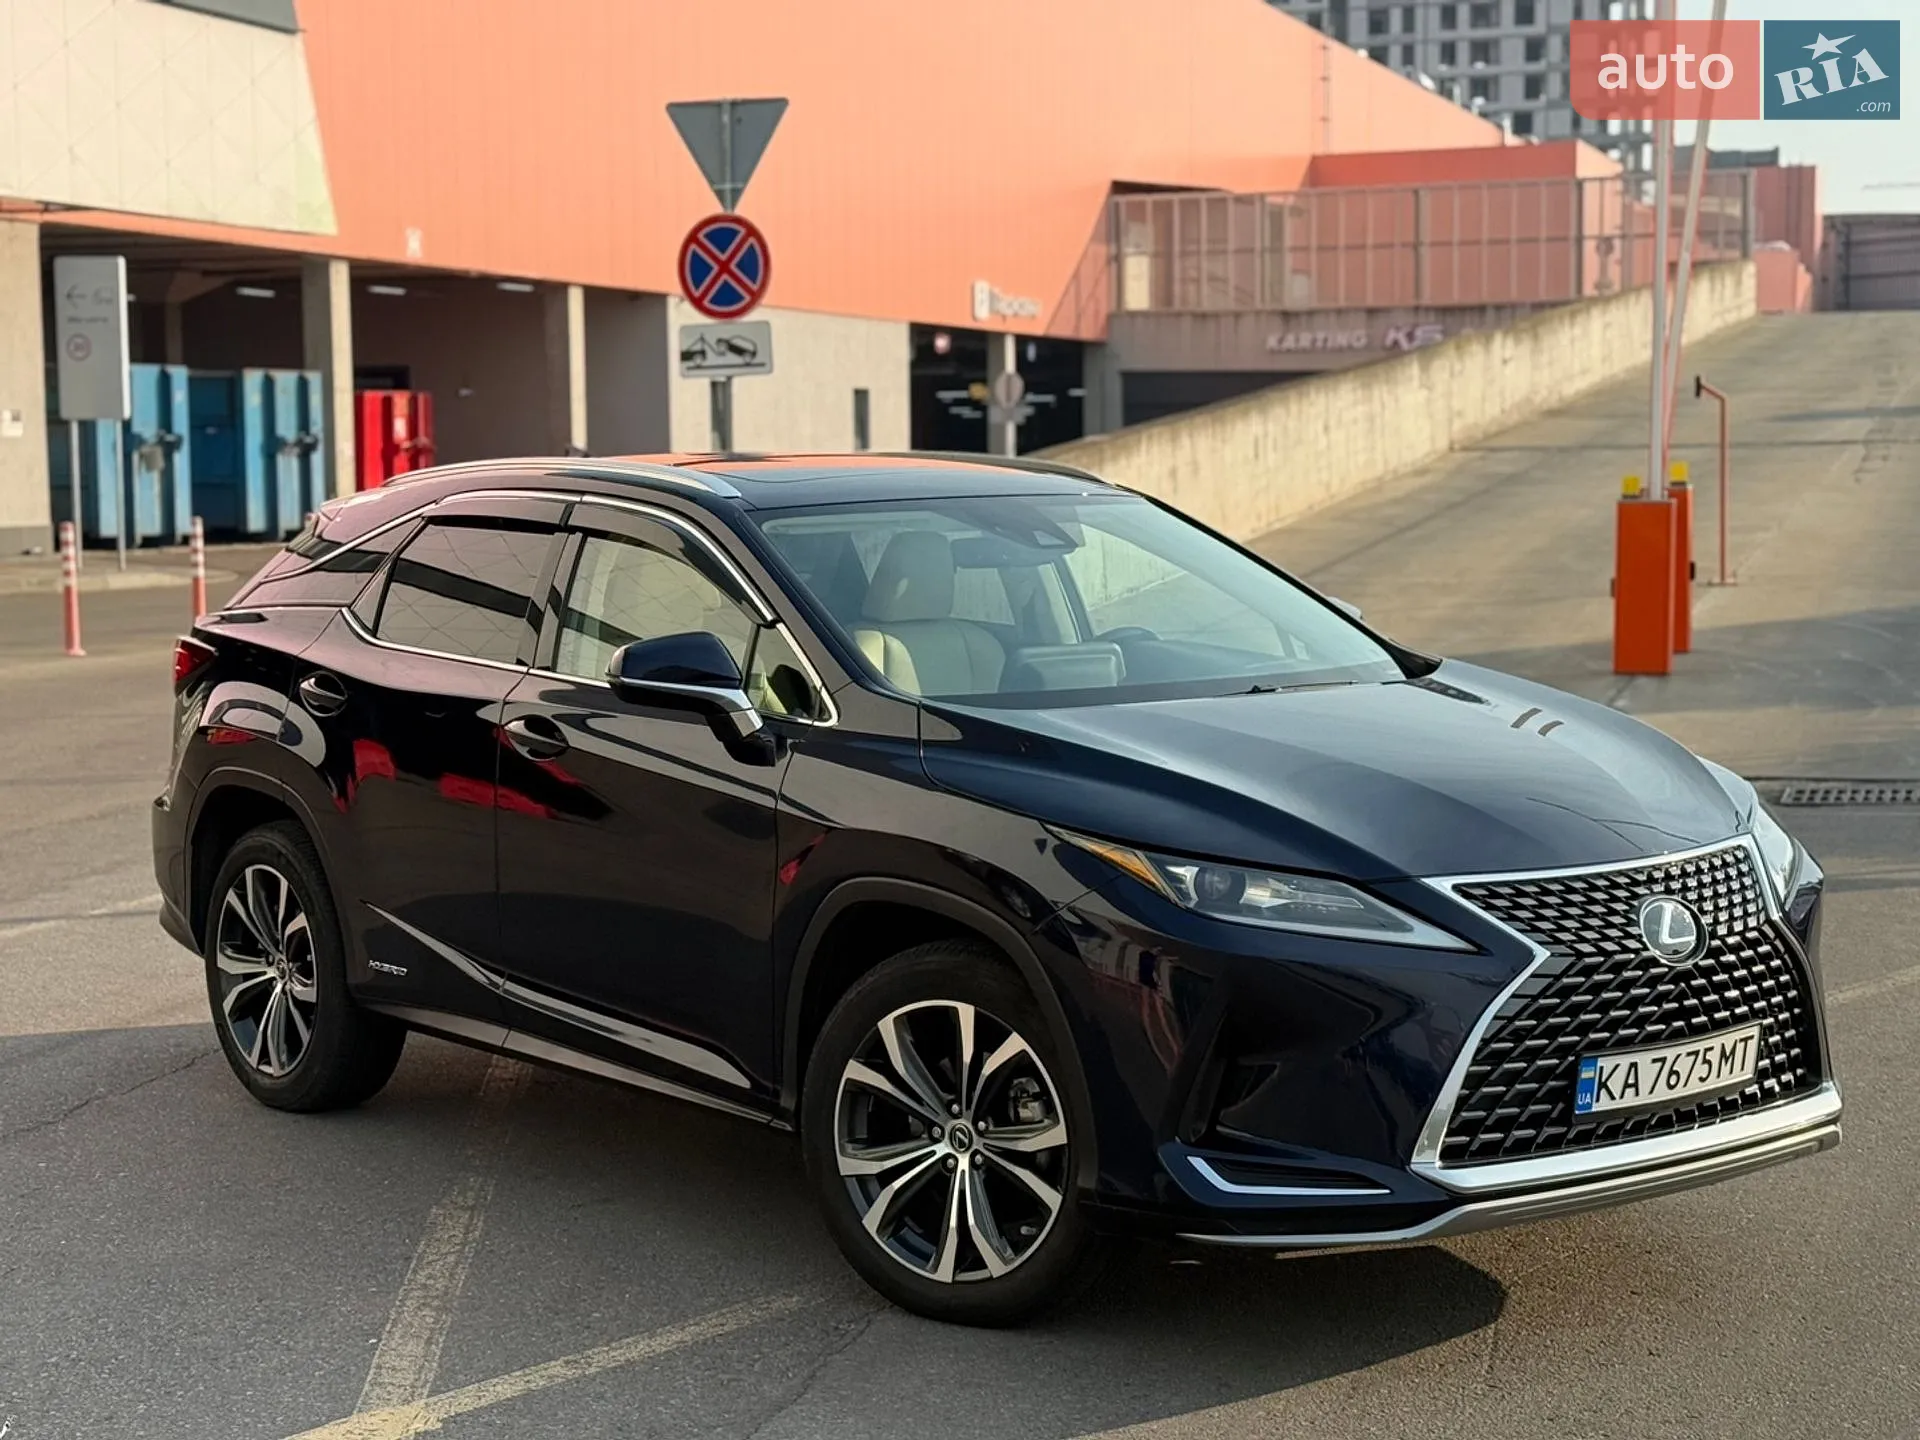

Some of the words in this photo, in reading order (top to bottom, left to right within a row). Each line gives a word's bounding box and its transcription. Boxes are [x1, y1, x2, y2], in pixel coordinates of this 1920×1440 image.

[1266, 329, 1368, 350] KARTING
[367, 959, 408, 977] HYBRID
[1578, 1092, 1592, 1105] UA
